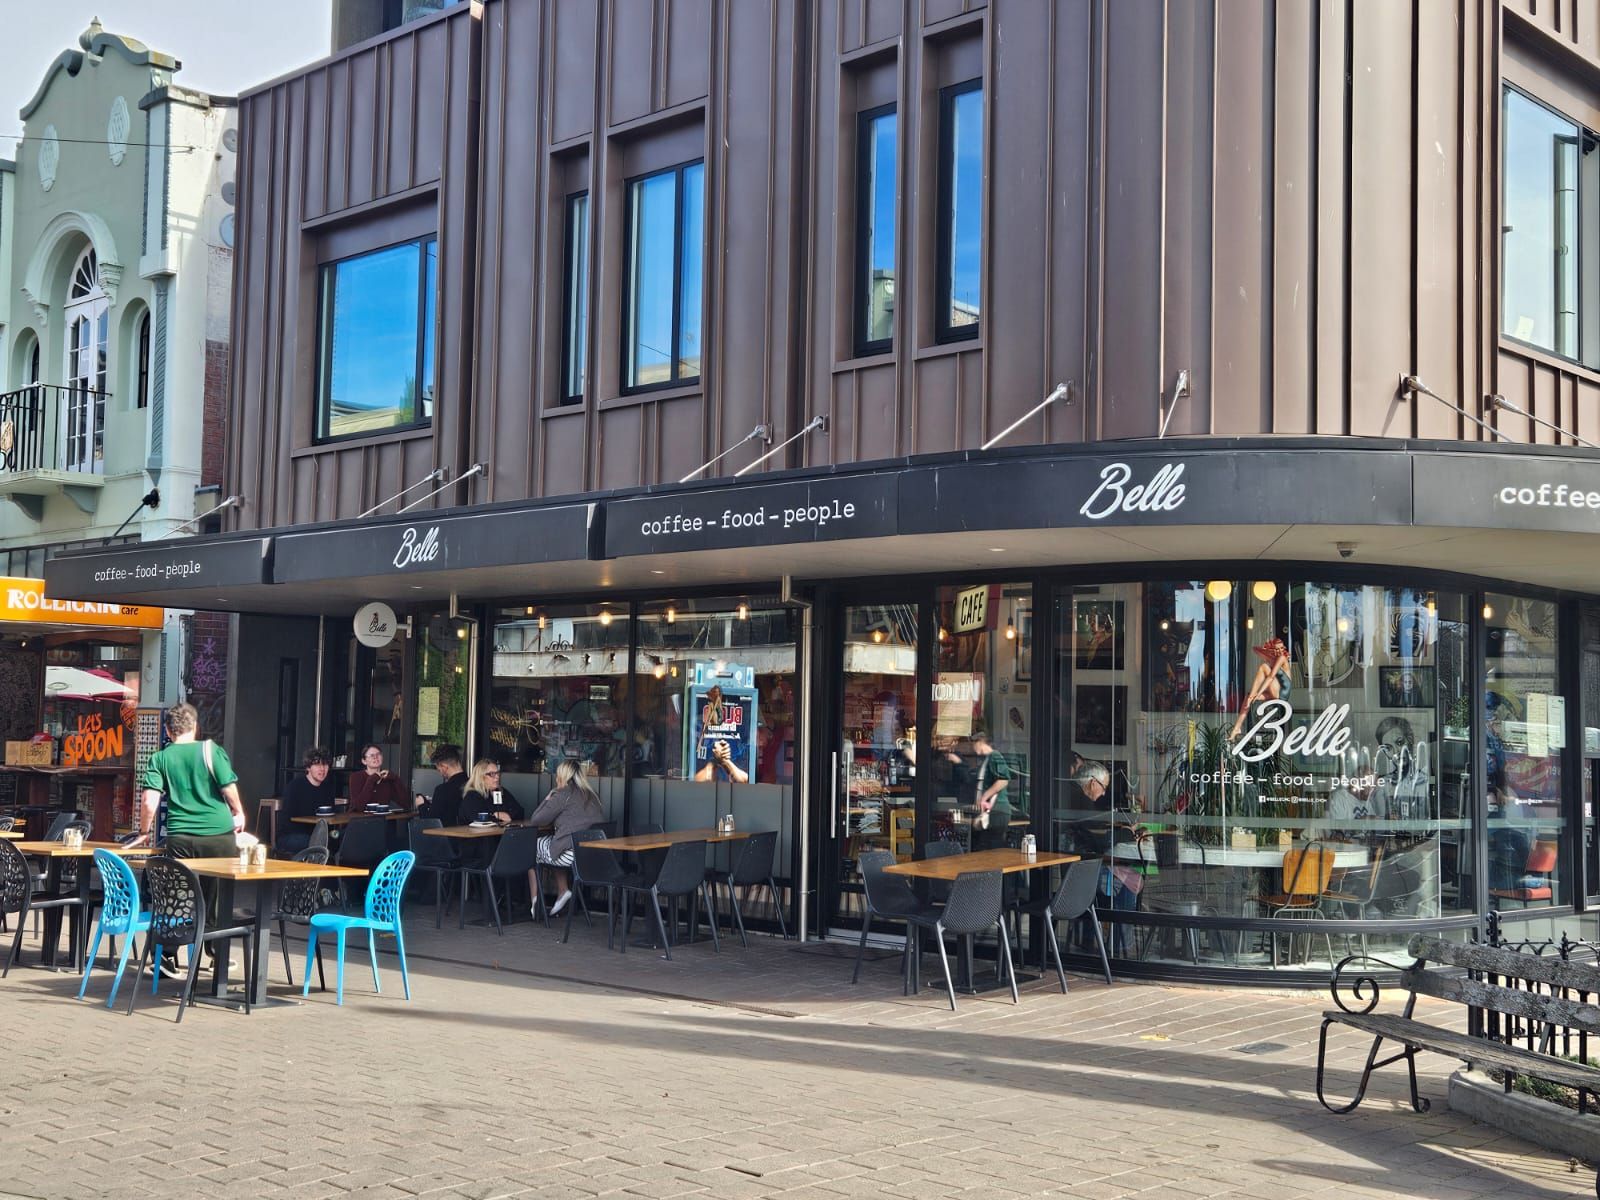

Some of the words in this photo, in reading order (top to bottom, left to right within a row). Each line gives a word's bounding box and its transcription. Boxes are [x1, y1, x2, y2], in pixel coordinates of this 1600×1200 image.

[1080, 463, 1186, 520] Belle
[1500, 483, 1600, 509] coffee
[393, 527, 440, 568] Belle
[960, 591, 984, 626] CAFE
[63, 724, 123, 768] SPOON
[1232, 699, 1351, 762] Belle
